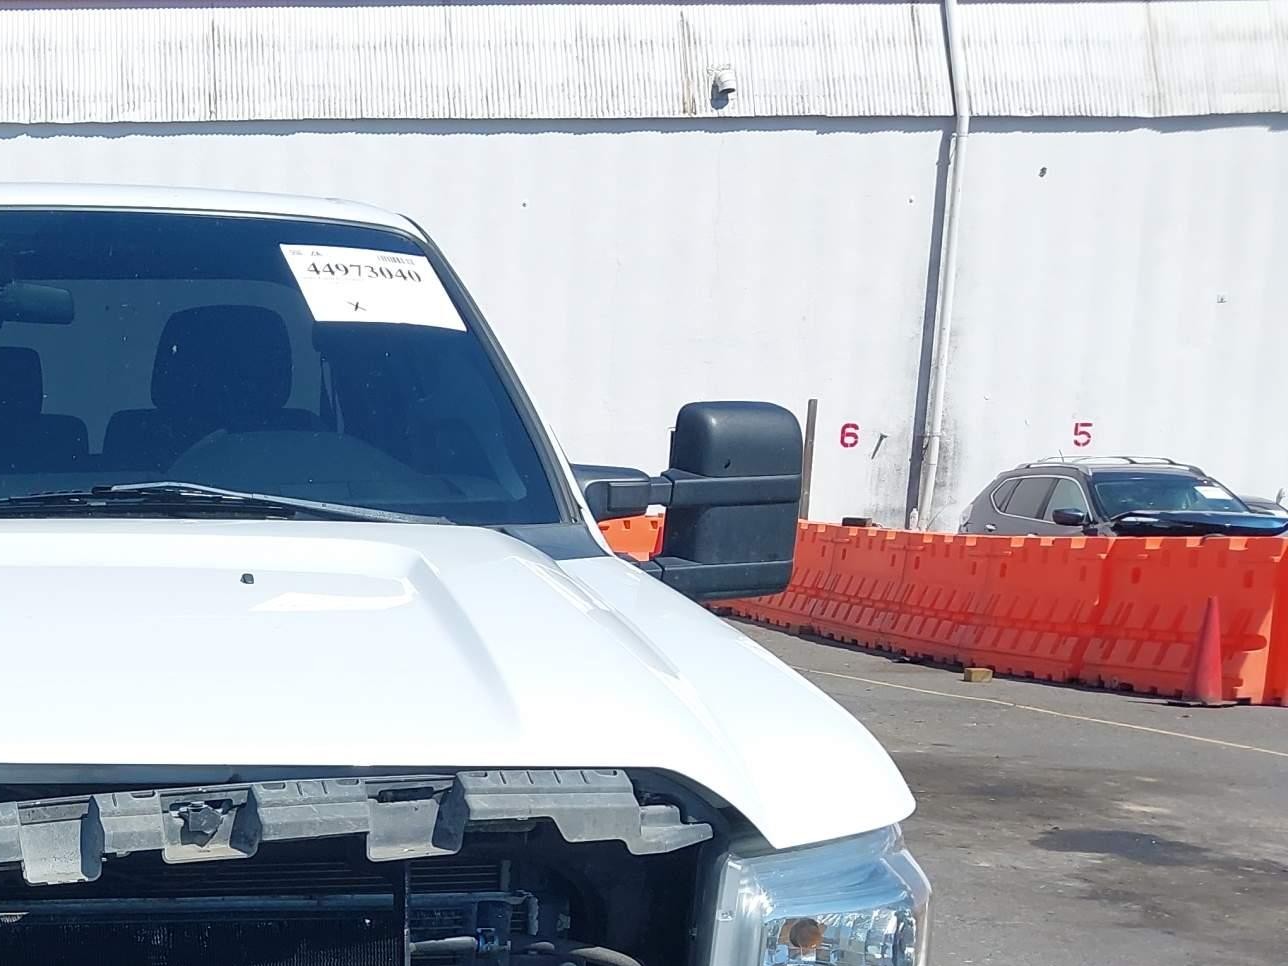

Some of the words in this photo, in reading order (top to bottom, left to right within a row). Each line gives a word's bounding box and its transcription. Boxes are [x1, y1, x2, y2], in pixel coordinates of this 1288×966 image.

[306, 262, 423, 283] 44973040
[840, 422, 860, 448] 6
[1072, 422, 1093, 447] 5
